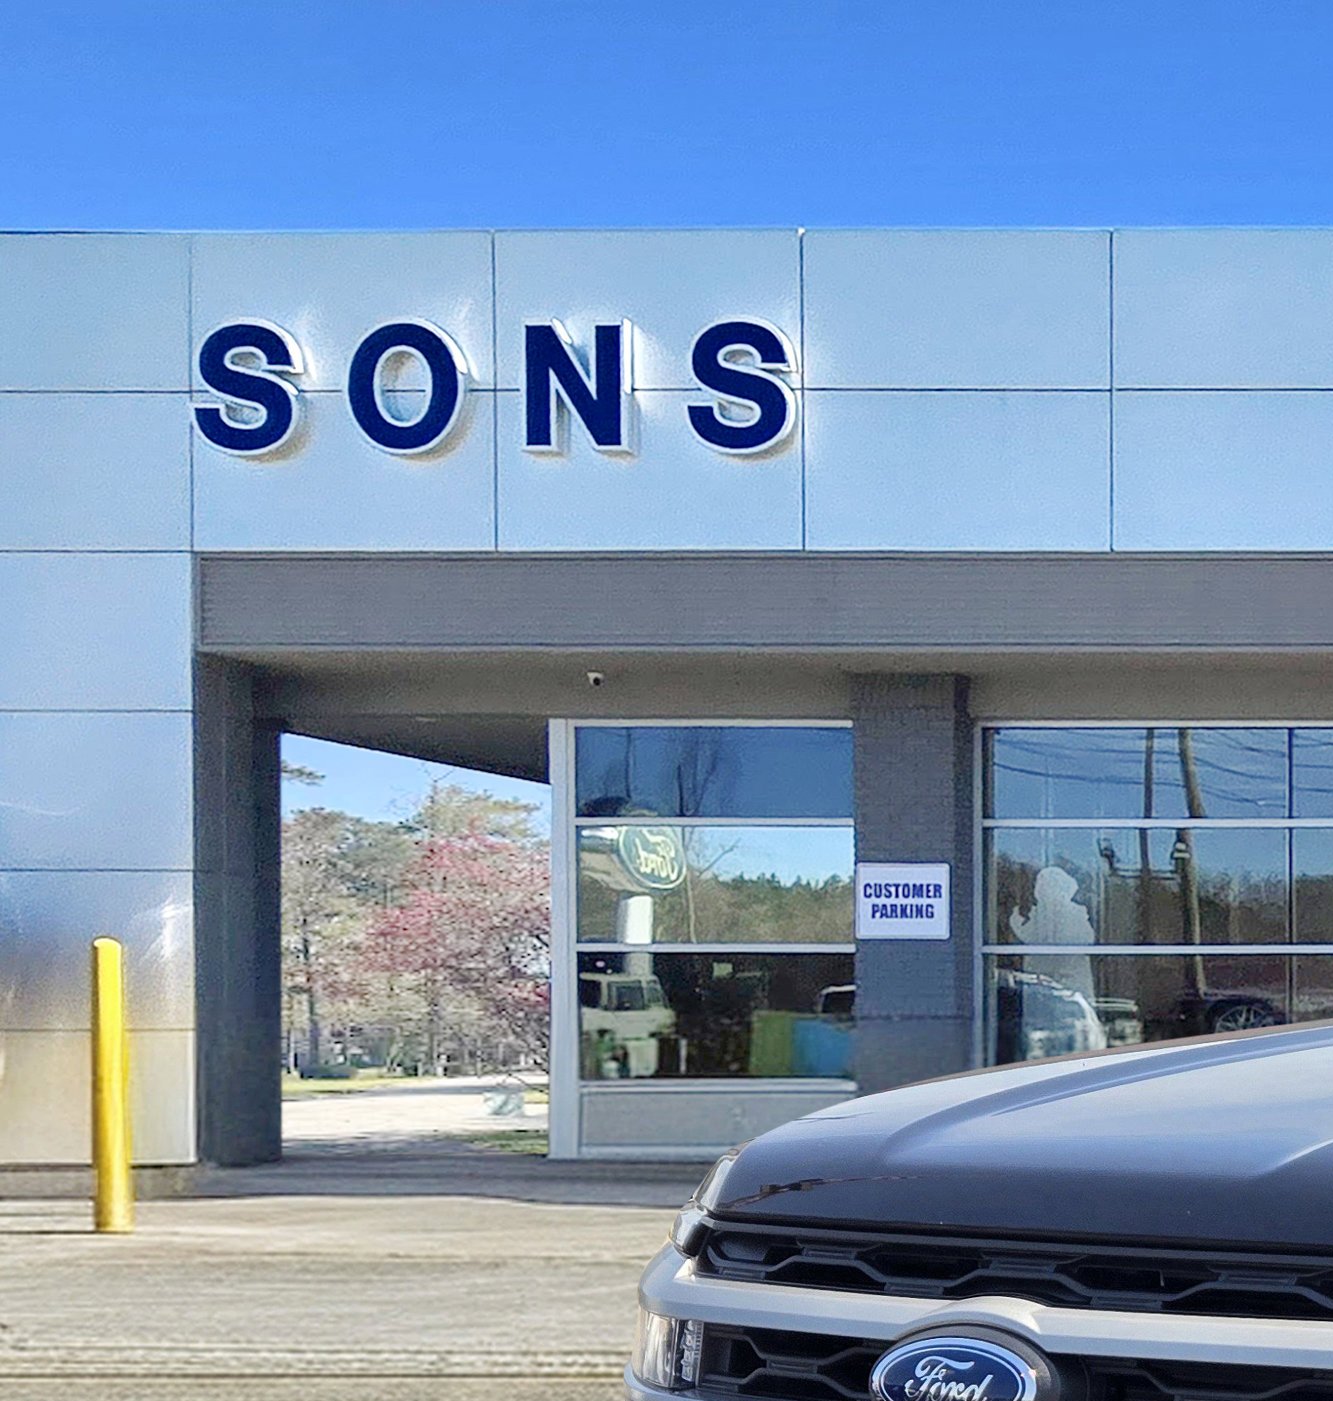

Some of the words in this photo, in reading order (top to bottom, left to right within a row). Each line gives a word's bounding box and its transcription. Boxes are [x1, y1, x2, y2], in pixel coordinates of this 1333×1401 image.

[194, 320, 797, 455] SONS
[863, 883, 943, 899] CUSTOMER
[871, 903, 935, 919] PARKING
